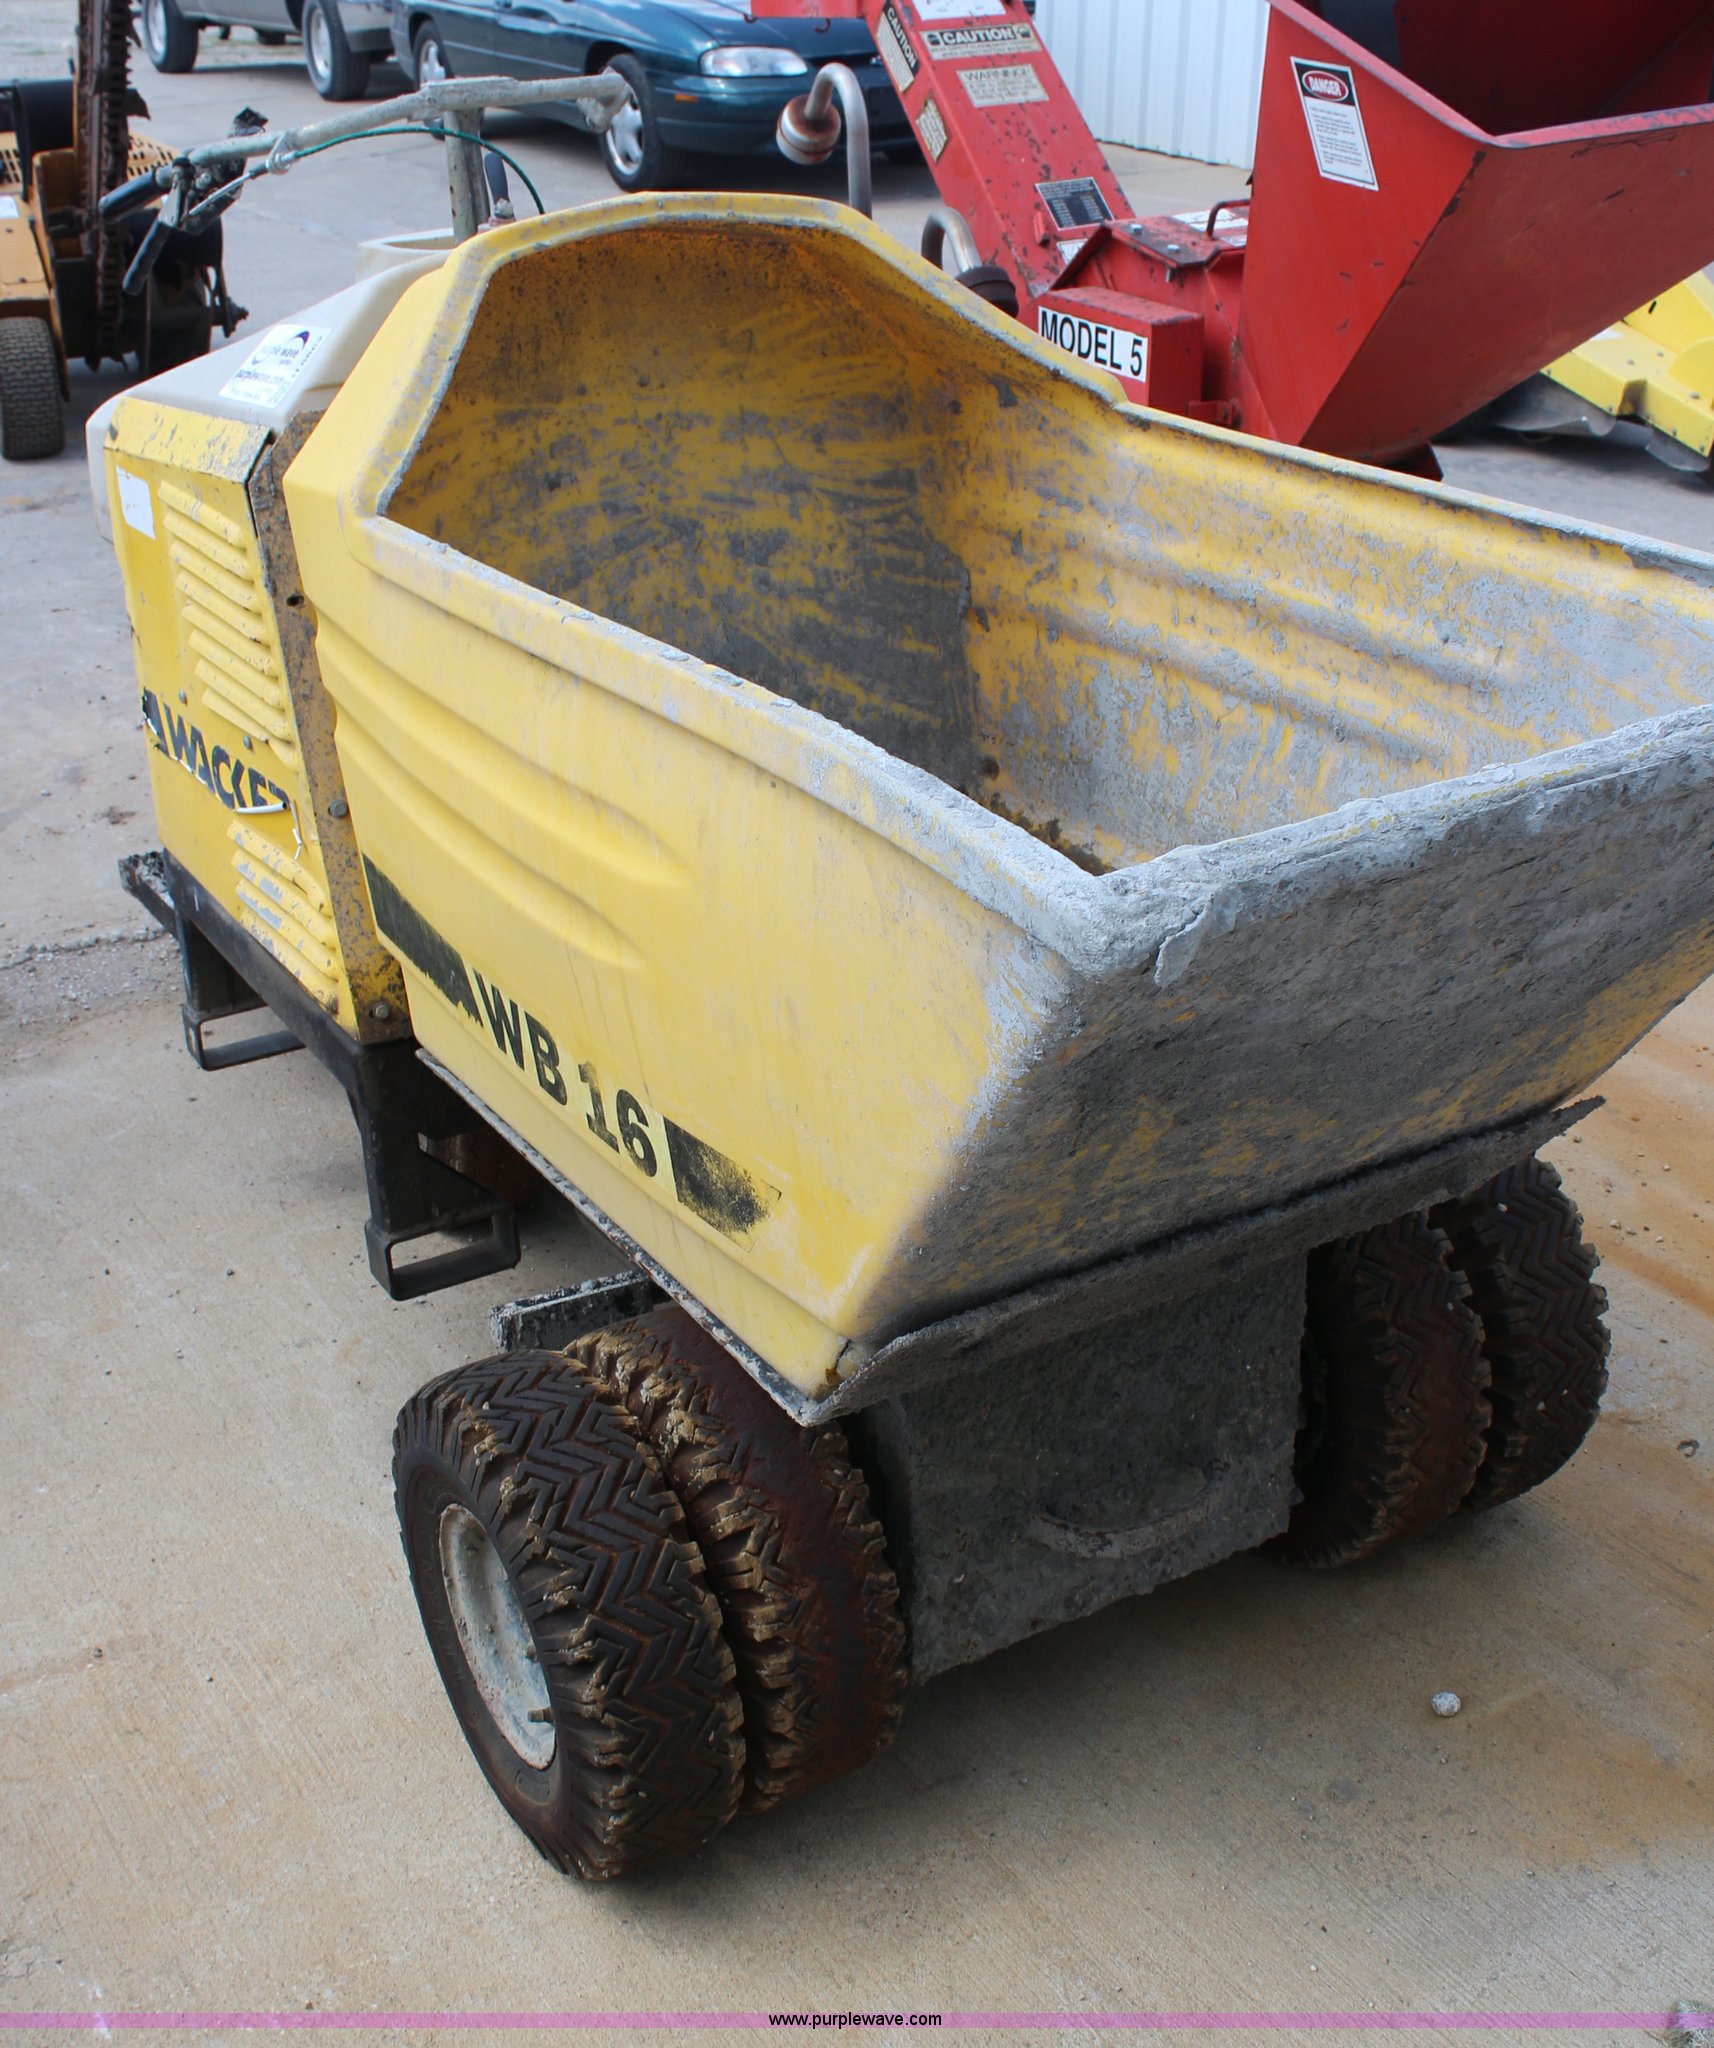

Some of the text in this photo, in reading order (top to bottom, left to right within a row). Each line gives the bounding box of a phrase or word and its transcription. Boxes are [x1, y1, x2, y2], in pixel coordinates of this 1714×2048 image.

[887, 7, 917, 68] CAUTION
[942, 26, 1014, 45] CAUTION
[1308, 75, 1342, 97] DANGER
[1041, 310, 1142, 377] MODEL 5
[472, 967, 658, 1178] WB 16
